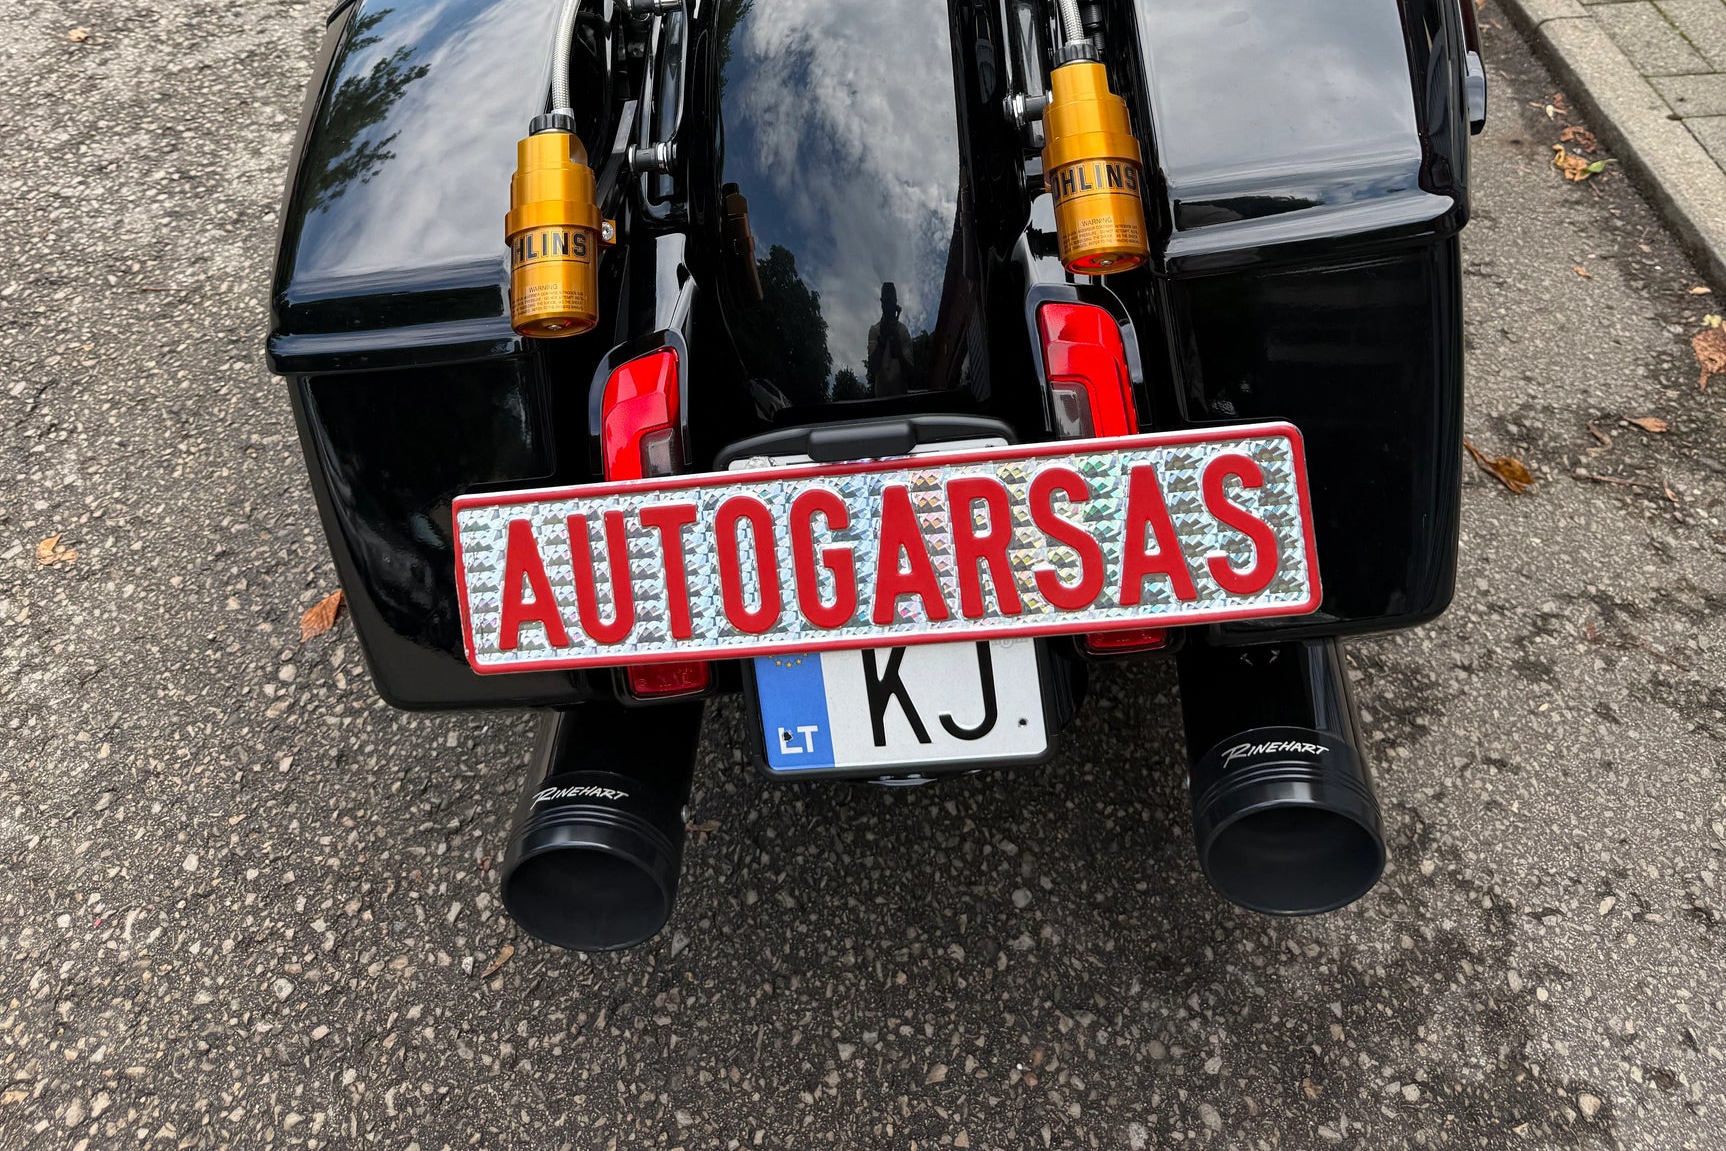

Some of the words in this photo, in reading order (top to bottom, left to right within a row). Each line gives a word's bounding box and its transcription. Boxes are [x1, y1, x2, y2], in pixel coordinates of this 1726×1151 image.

[1081, 216, 1113, 227] WARNING
[528, 283, 559, 293] WARNING
[497, 452, 1281, 651] AUTOGARSAS
[860, 639, 999, 748] KJ
[777, 724, 819, 756] LT
[1221, 740, 1330, 769] RINEHART
[530, 785, 629, 811] RINEHART
